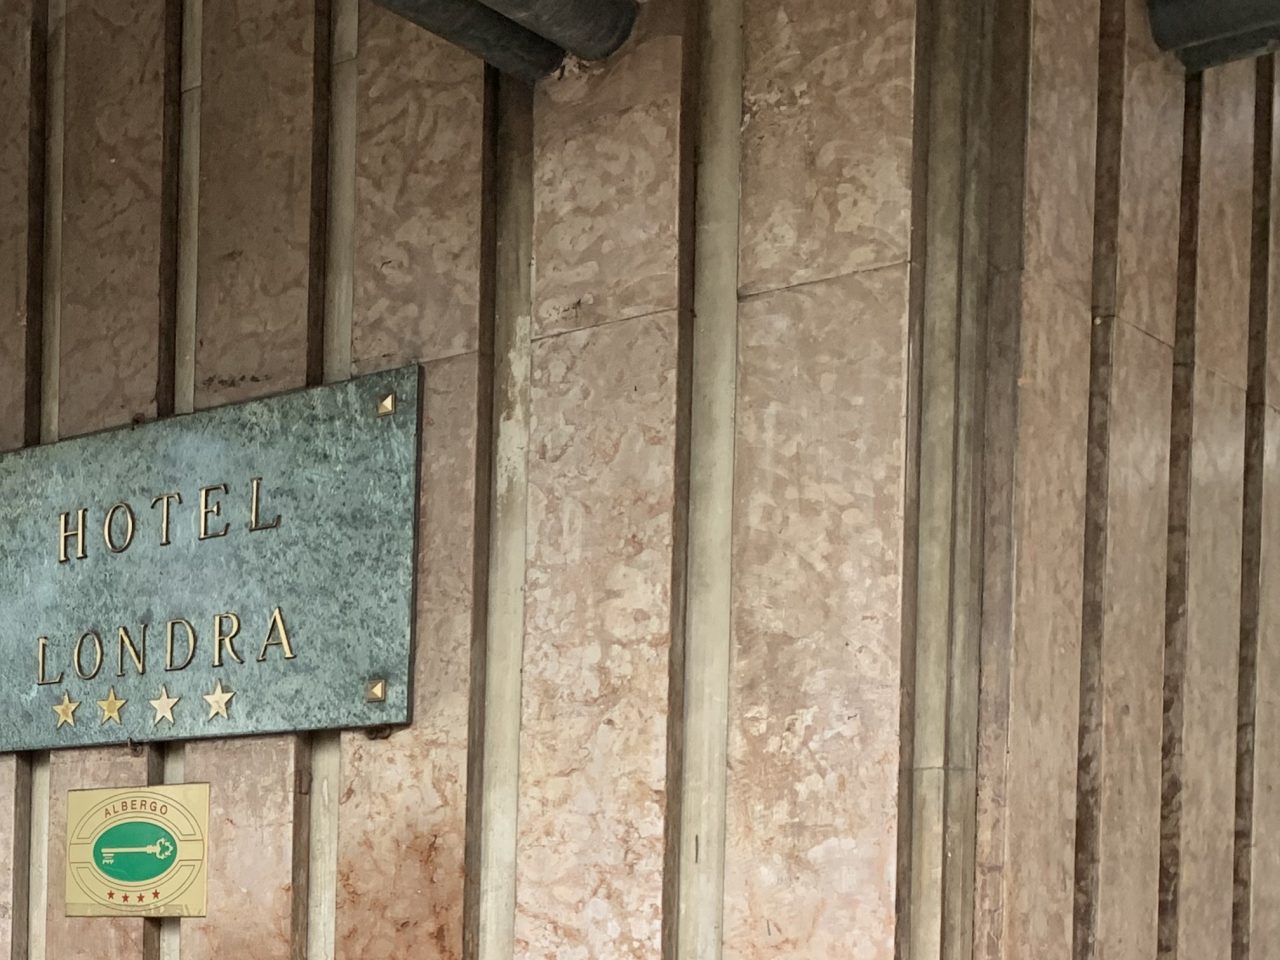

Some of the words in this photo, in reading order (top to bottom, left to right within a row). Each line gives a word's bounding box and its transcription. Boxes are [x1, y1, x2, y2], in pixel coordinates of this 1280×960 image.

[58, 476, 283, 564] HOTEL
[36, 606, 297, 687] LONDRA
[104, 799, 169, 819] ALBERGO
